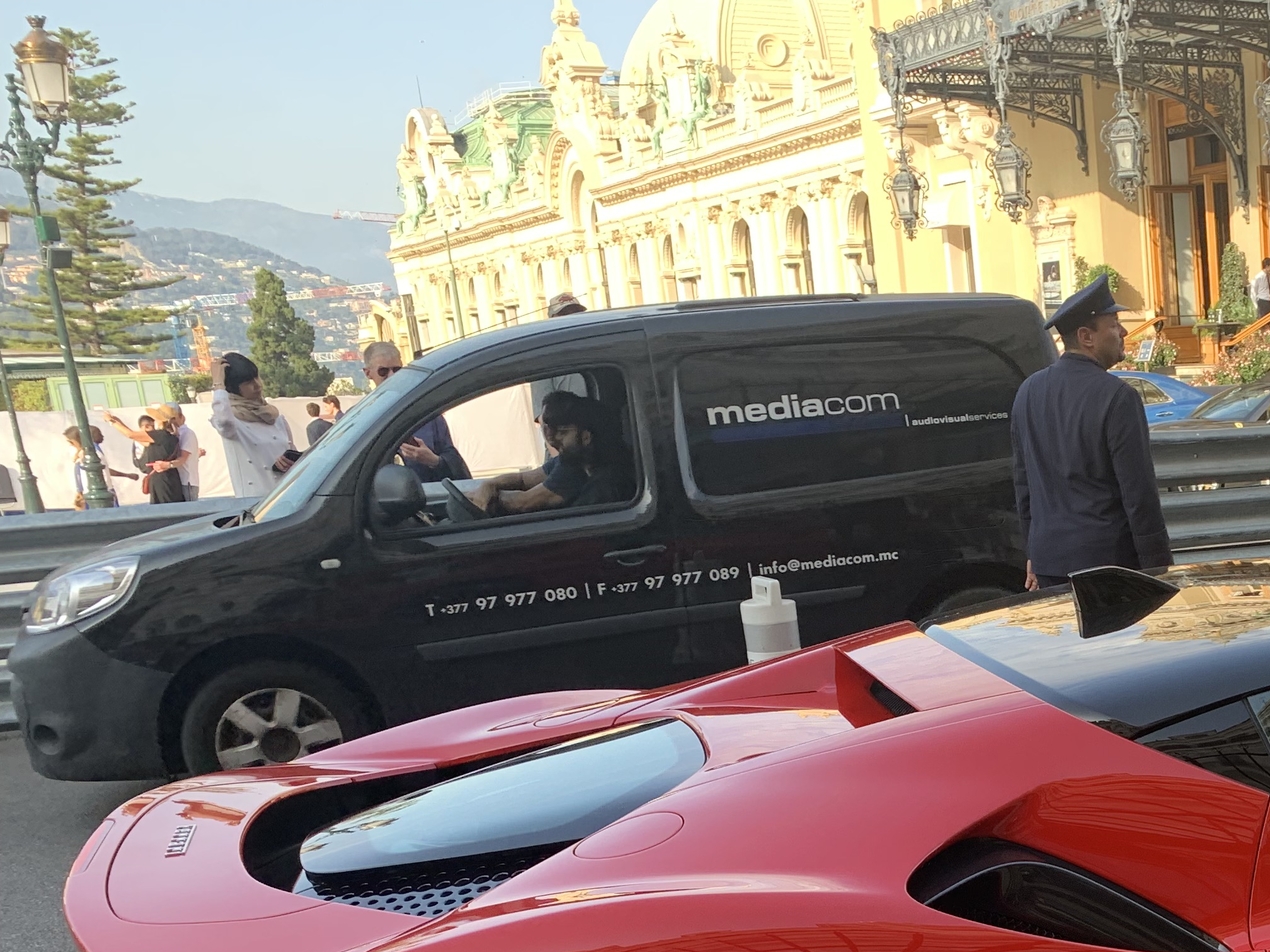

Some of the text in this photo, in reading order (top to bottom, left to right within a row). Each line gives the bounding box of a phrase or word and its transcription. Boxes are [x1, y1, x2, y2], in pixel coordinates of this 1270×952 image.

[707, 392, 900, 426] mediacom
[425, 603, 435, 617] T
[475, 596, 498, 611] 97
[505, 591, 537, 607] 977
[544, 586, 578, 603] 080
[597, 582, 607, 596] F
[644, 575, 665, 590] 97
[671, 571, 703, 586] 977
[709, 566, 740, 582] 089
[758, 551, 899, 576] info@mediacom.mc
